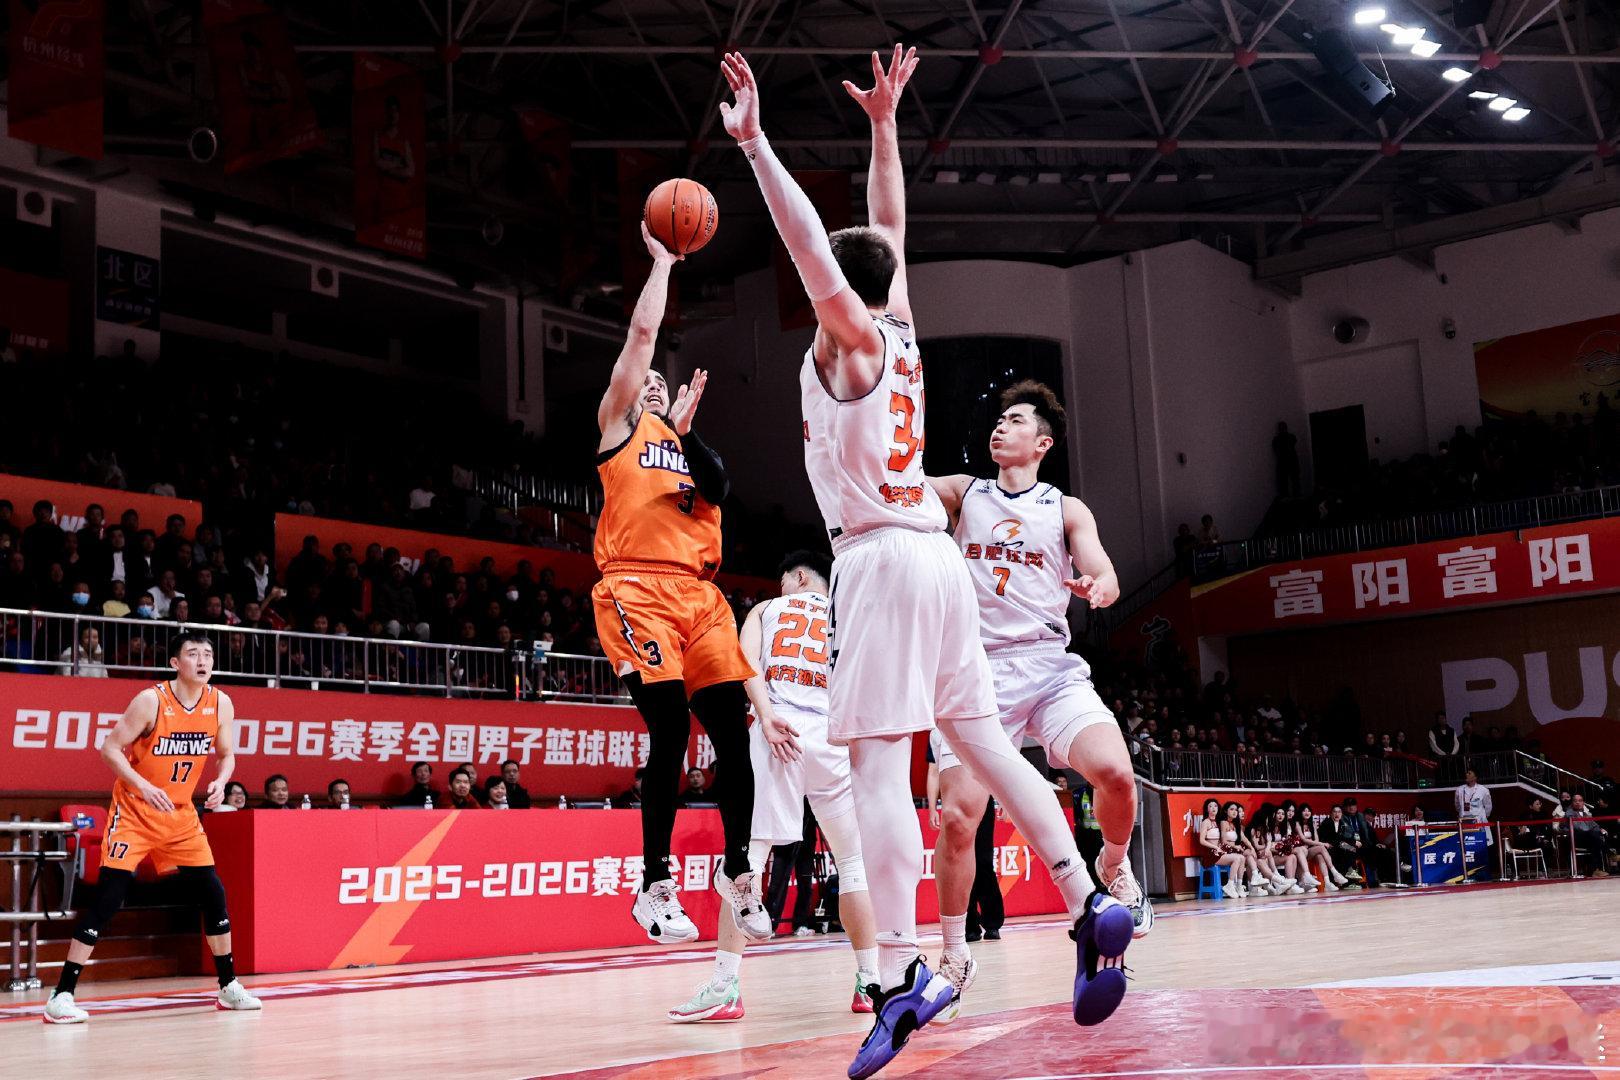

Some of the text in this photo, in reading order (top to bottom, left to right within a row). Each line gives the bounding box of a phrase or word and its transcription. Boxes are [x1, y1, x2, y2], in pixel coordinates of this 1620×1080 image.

[677, 481, 697, 514] 3
[992, 566, 1011, 597] 7
[642, 639, 664, 667] 3
[771, 611, 829, 665] 25
[1441, 645, 1620, 738] PU
[170, 761, 194, 783] 17
[109, 841, 129, 860] 17
